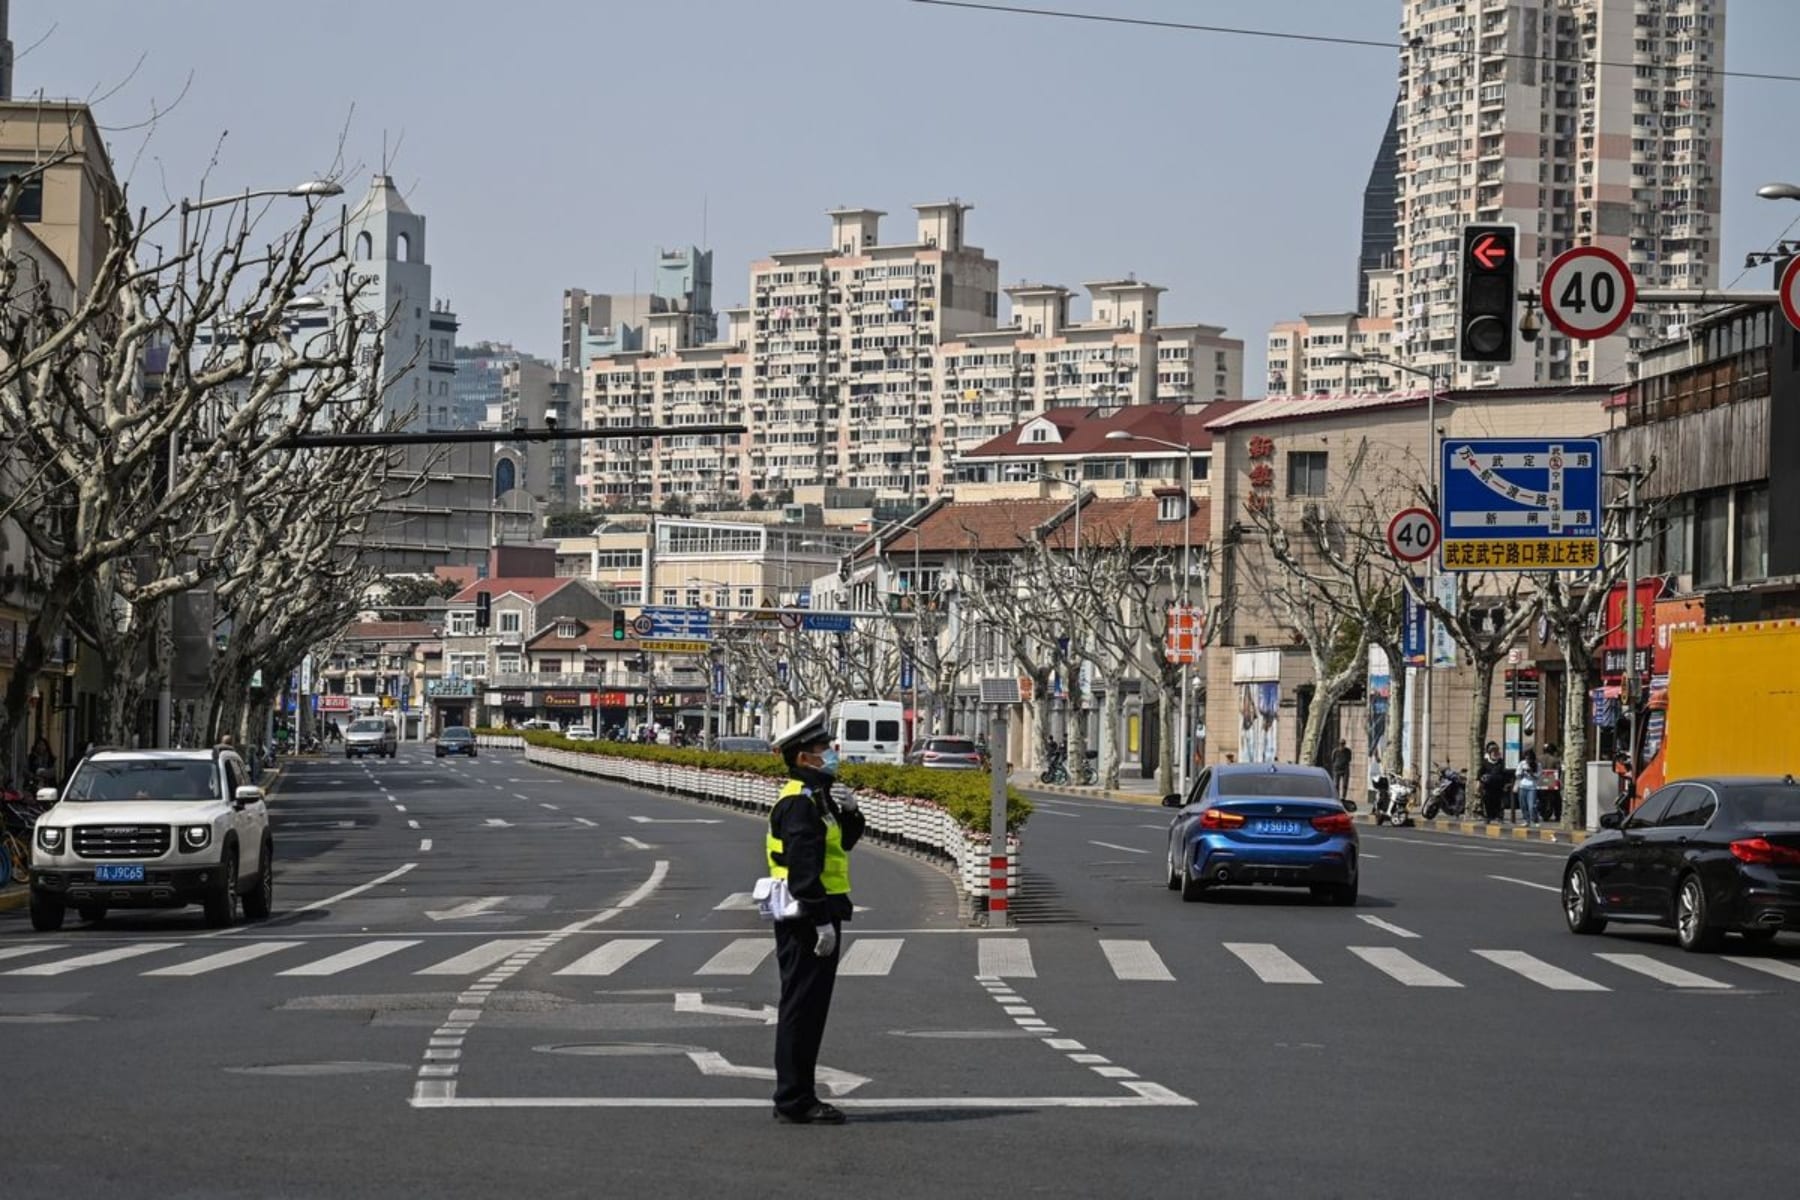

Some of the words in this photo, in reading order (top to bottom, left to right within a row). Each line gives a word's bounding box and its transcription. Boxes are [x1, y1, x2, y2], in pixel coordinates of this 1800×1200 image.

[336, 272, 379, 288] UCove
[1560, 271, 1616, 313] 40
[1397, 523, 1431, 547] 40
[1446, 542, 1595, 565] 武定武宁路口禁止左转
[636, 619, 650, 630] 40
